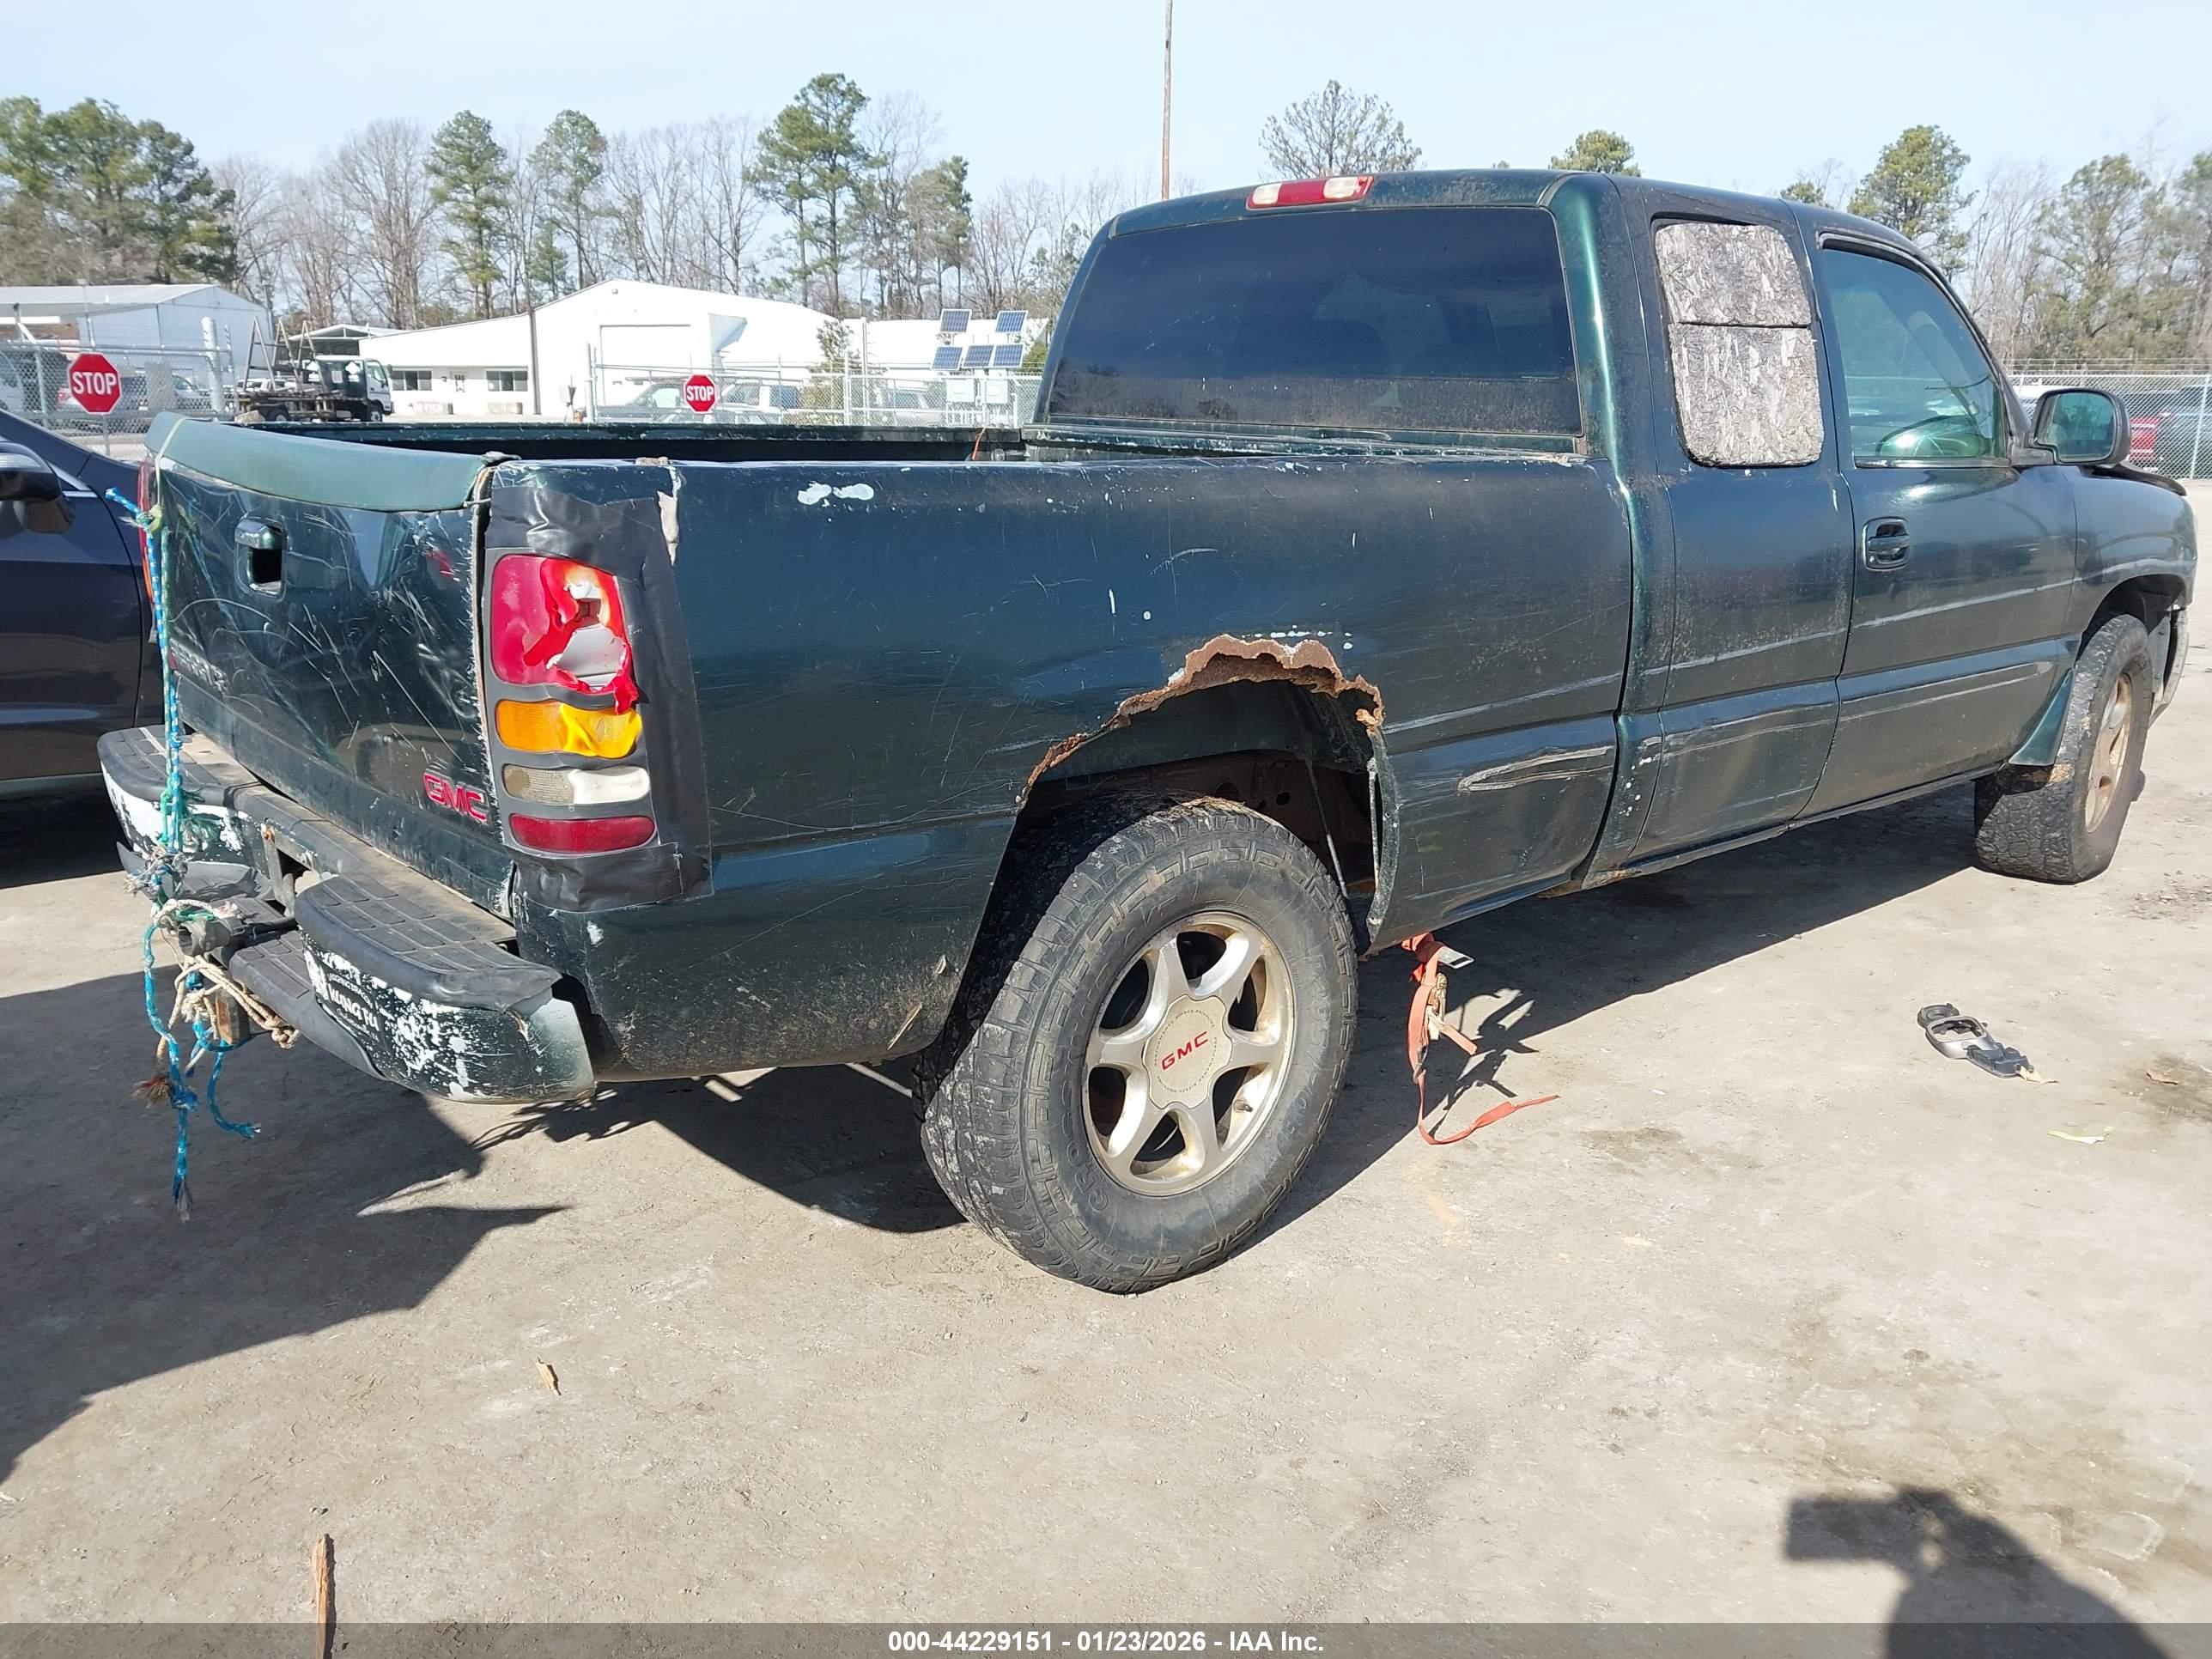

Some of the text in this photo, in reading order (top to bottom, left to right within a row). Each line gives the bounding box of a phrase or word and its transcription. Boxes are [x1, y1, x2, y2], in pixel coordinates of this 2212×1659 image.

[72, 371, 117, 395] STOP
[687, 386, 714, 401] STOP
[423, 773, 487, 822] GMC
[328, 983, 362, 1020] KUNG
[362, 1007, 380, 1030] FU
[1161, 1030, 1208, 1071] GMC
